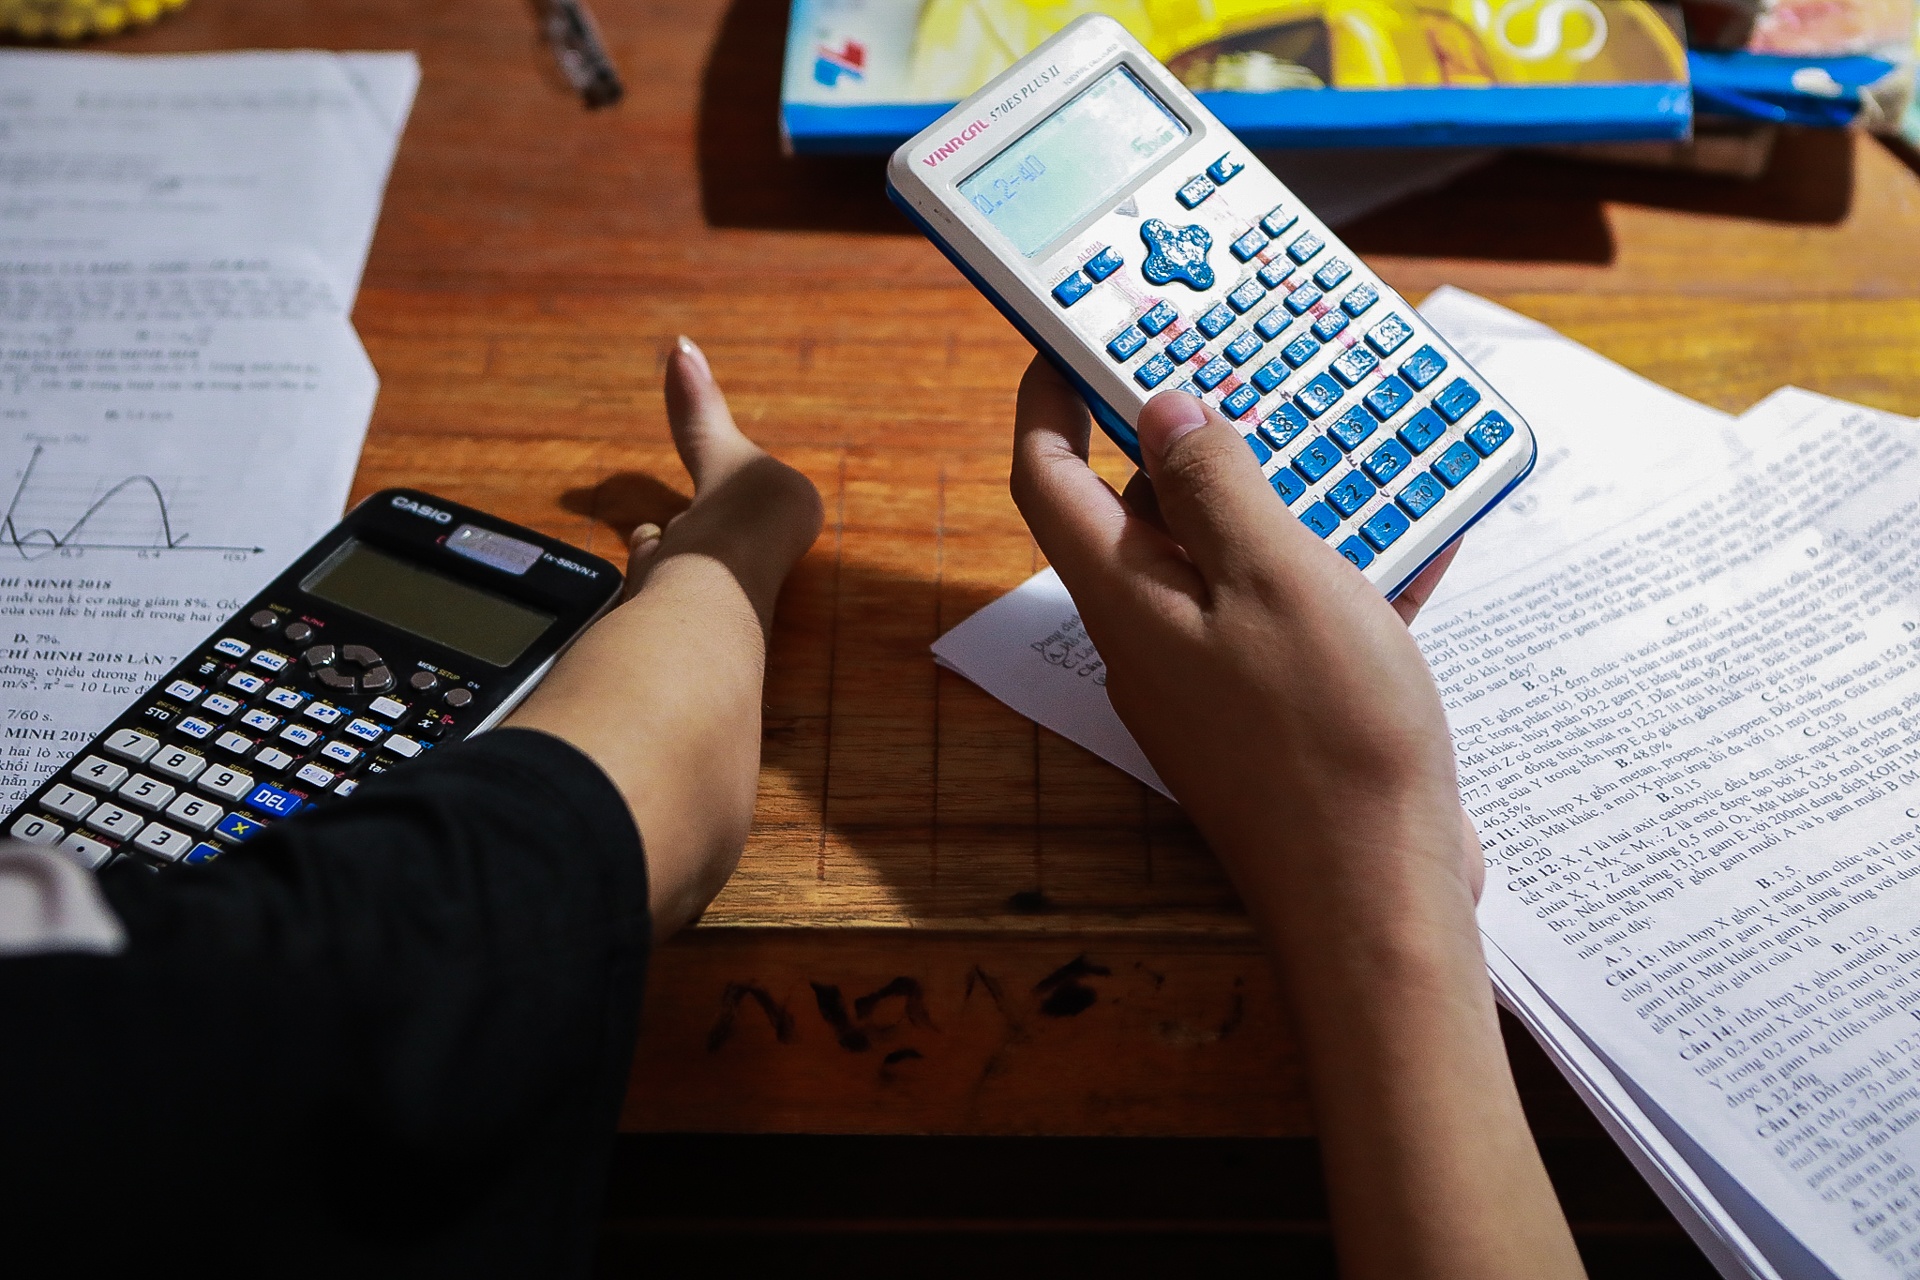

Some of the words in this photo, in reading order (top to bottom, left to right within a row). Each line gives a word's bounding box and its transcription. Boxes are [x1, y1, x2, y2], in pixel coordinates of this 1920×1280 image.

[989, 90, 1023, 122] 570ES
[1021, 73, 1050, 104] PLUS
[1077, 241, 1105, 263] ALPHA
[1047, 266, 1074, 287] SHIFT
[1117, 330, 1144, 352] CALC
[1233, 336, 1257, 356] hyp
[1232, 388, 1255, 409] ENG
[1312, 449, 1327, 467] 5
[1381, 452, 1398, 470] 3
[1447, 452, 1472, 475] Ans
[1278, 481, 1292, 497] 4
[1346, 483, 1363, 501] 2
[391, 496, 452, 524] CASIO
[25, 578, 73, 588] MINH
[78, 579, 112, 589] 2018
[150, 610, 185, 622] trong
[219, 641, 246, 655] OPTN
[33, 650, 82, 661] MINH
[88, 652, 123, 663] 2018
[256, 654, 281, 668] CALC
[46, 664, 85, 678] chiều
[417, 660, 437, 672] MENU
[436, 668, 461, 681] SETUP
[1521, 680, 1539, 691] B.
[1537, 665, 1567, 683] 0,48
[467, 681, 481, 690] ON
[1760, 692, 1778, 702] C.
[7, 709, 39, 721] 7/60
[145, 706, 170, 721] STO
[183, 720, 207, 736] ENG
[1802, 726, 1820, 736] C.
[1818, 712, 1847, 730] 0,30
[4, 727, 55, 740] MINH
[122, 734, 143, 748] 7
[290, 728, 308, 741] sin
[8, 746, 32, 757] hai
[37, 747, 51, 758] lò
[331, 745, 352, 758] cos
[1613, 758, 1632, 768] B.
[1632, 737, 1672, 760] 48,0%
[167, 753, 186, 768] 8
[89, 763, 108, 778] 4
[1496, 827, 1519, 840] 11:
[1517, 813, 1549, 829] Hỗn
[1546, 802, 1574, 817] hợp
[1572, 793, 1589, 805] X
[1589, 782, 1618, 800] gồm
[1618, 765, 1662, 784] metan,
[1661, 746, 1708, 769] propen,
[1706, 734, 1724, 746] và
[1720, 715, 1770, 739] isopren.
[214, 772, 234, 787] 9
[140, 781, 157, 796] 5
[1655, 792, 1674, 803] B.
[1672, 778, 1701, 795] 0,15
[59, 792, 75, 806] 1
[254, 789, 287, 812] DEL
[183, 801, 201, 816] 6
[1507, 875, 1538, 891] Câu
[1537, 863, 1561, 877] 12:
[1559, 854, 1582, 866] X,
[1578, 845, 1593, 856] Y
[1593, 839, 1610, 850] là
[1607, 828, 1631, 844] hai
[1632, 817, 1658, 833] axit
[1658, 789, 1723, 823] cacboxylic
[1807, 734, 1841, 754] mạch
[103, 811, 123, 826] 2
[24, 822, 44, 838] 0
[151, 830, 172, 846] 3
[1506, 865, 1523, 875] A.
[1521, 847, 1552, 866] 0,20
[1562, 930, 1587, 945] thu
[1618, 892, 1648, 916] hỗn
[1645, 887, 1674, 903] hợp
[1672, 878, 1684, 889] F
[1688, 866, 1718, 885] gồm
[1718, 852, 1748, 871] gam
[1747, 832, 1782, 854] muối
[1782, 828, 1796, 838] A
[1795, 819, 1814, 830] và
[1810, 815, 1824, 824] b
[1825, 804, 1853, 821] gam
[1853, 786, 1886, 807] muối
[1882, 780, 1898, 791] B
[1755, 878, 1775, 889] B.
[1772, 865, 1800, 881] 3,5.
[1605, 967, 1637, 986] Câu
[1636, 954, 1660, 969] 13:
[1657, 940, 1690, 957] Hỗn
[1686, 926, 1715, 942] hợp
[1712, 917, 1730, 929] X
[1730, 905, 1760, 925] gồm
[1830, 942, 1851, 954] B.
[1848, 925, 1884, 945] 12,9.
[1605, 955, 1621, 967] A.
